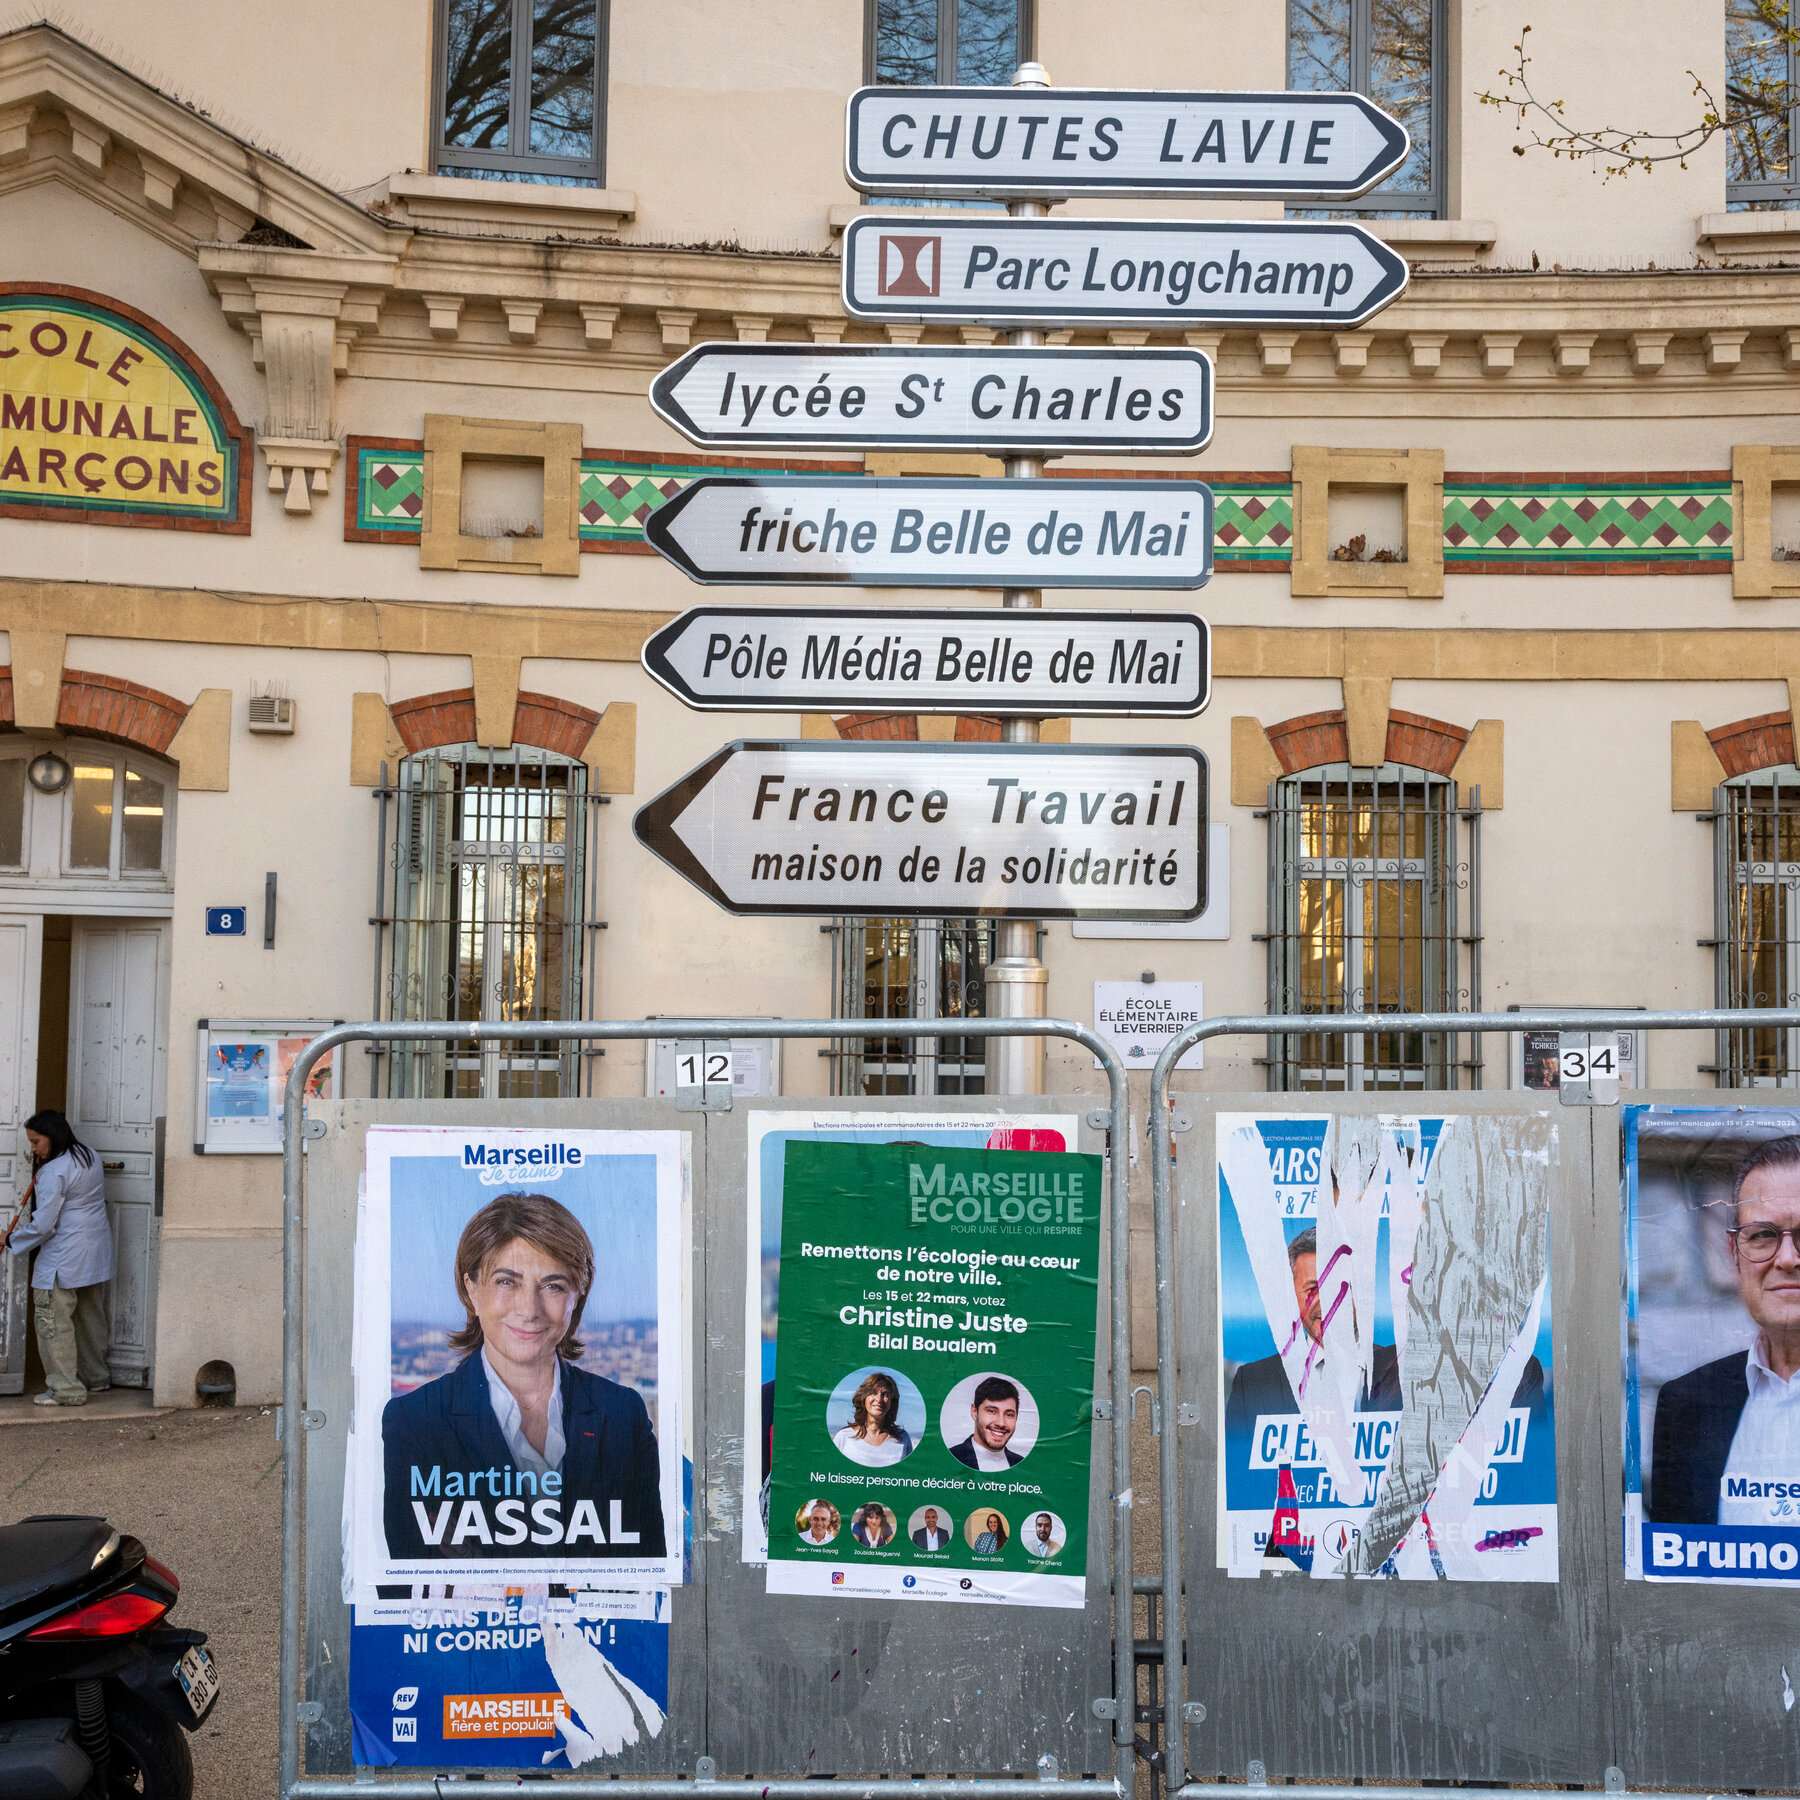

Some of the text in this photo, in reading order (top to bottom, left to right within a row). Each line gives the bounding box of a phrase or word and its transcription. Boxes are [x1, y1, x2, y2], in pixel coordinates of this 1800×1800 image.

[881, 114, 1336, 165] CHUTES LAVIE
[964, 245, 1355, 306] Parc Longchamp
[719, 371, 1186, 427] lycée St Charles
[739, 506, 1191, 557] friche Belle de Mai
[703, 632, 1184, 685] Pôle Média Belle de Mai
[751, 775, 1186, 827] France Travail
[751, 844, 1179, 887] maison de la solidarité
[220, 914, 232, 929] 8
[1126, 997, 1172, 1010] ÉCOLE
[1100, 1009, 1198, 1022] ÉLÉMENTAIRE
[1114, 1024, 1184, 1034] LEVERRIER
[464, 1144, 582, 1165] Marseille
[483, 1165, 504, 1180] Je
[910, 1164, 1084, 1196] MARSEILLE
[912, 1197, 1084, 1224] ECOLOG!E
[950, 1225, 1082, 1235] POUR UNE VILLE QUI RESPIRE
[801, 1243, 1080, 1270] Remettons l'écologie au cœur
[876, 1266, 1002, 1286] de notre ville.
[863, 1290, 1006, 1307] Les 15 et 22 mars, votez
[839, 1306, 1028, 1334] Christine Juste
[868, 1334, 997, 1355] Bilal Boualem
[410, 1465, 562, 1497] Martine
[810, 1472, 1043, 1495] Ne laissez personne décider à votre place.
[1770, 1500, 1792, 1517] Je
[411, 1499, 640, 1545] VASSAL
[1484, 1530, 1528, 1546] RPR
[1652, 1532, 1798, 1570] Bruno
[403, 1633, 428, 1653] NI
[396, 1694, 415, 1703] REV
[450, 1700, 566, 1719] MARSEILLE
[396, 1721, 414, 1736] VAÏ
[451, 1720, 480, 1732] fière
[485, 1720, 499, 1731] et
